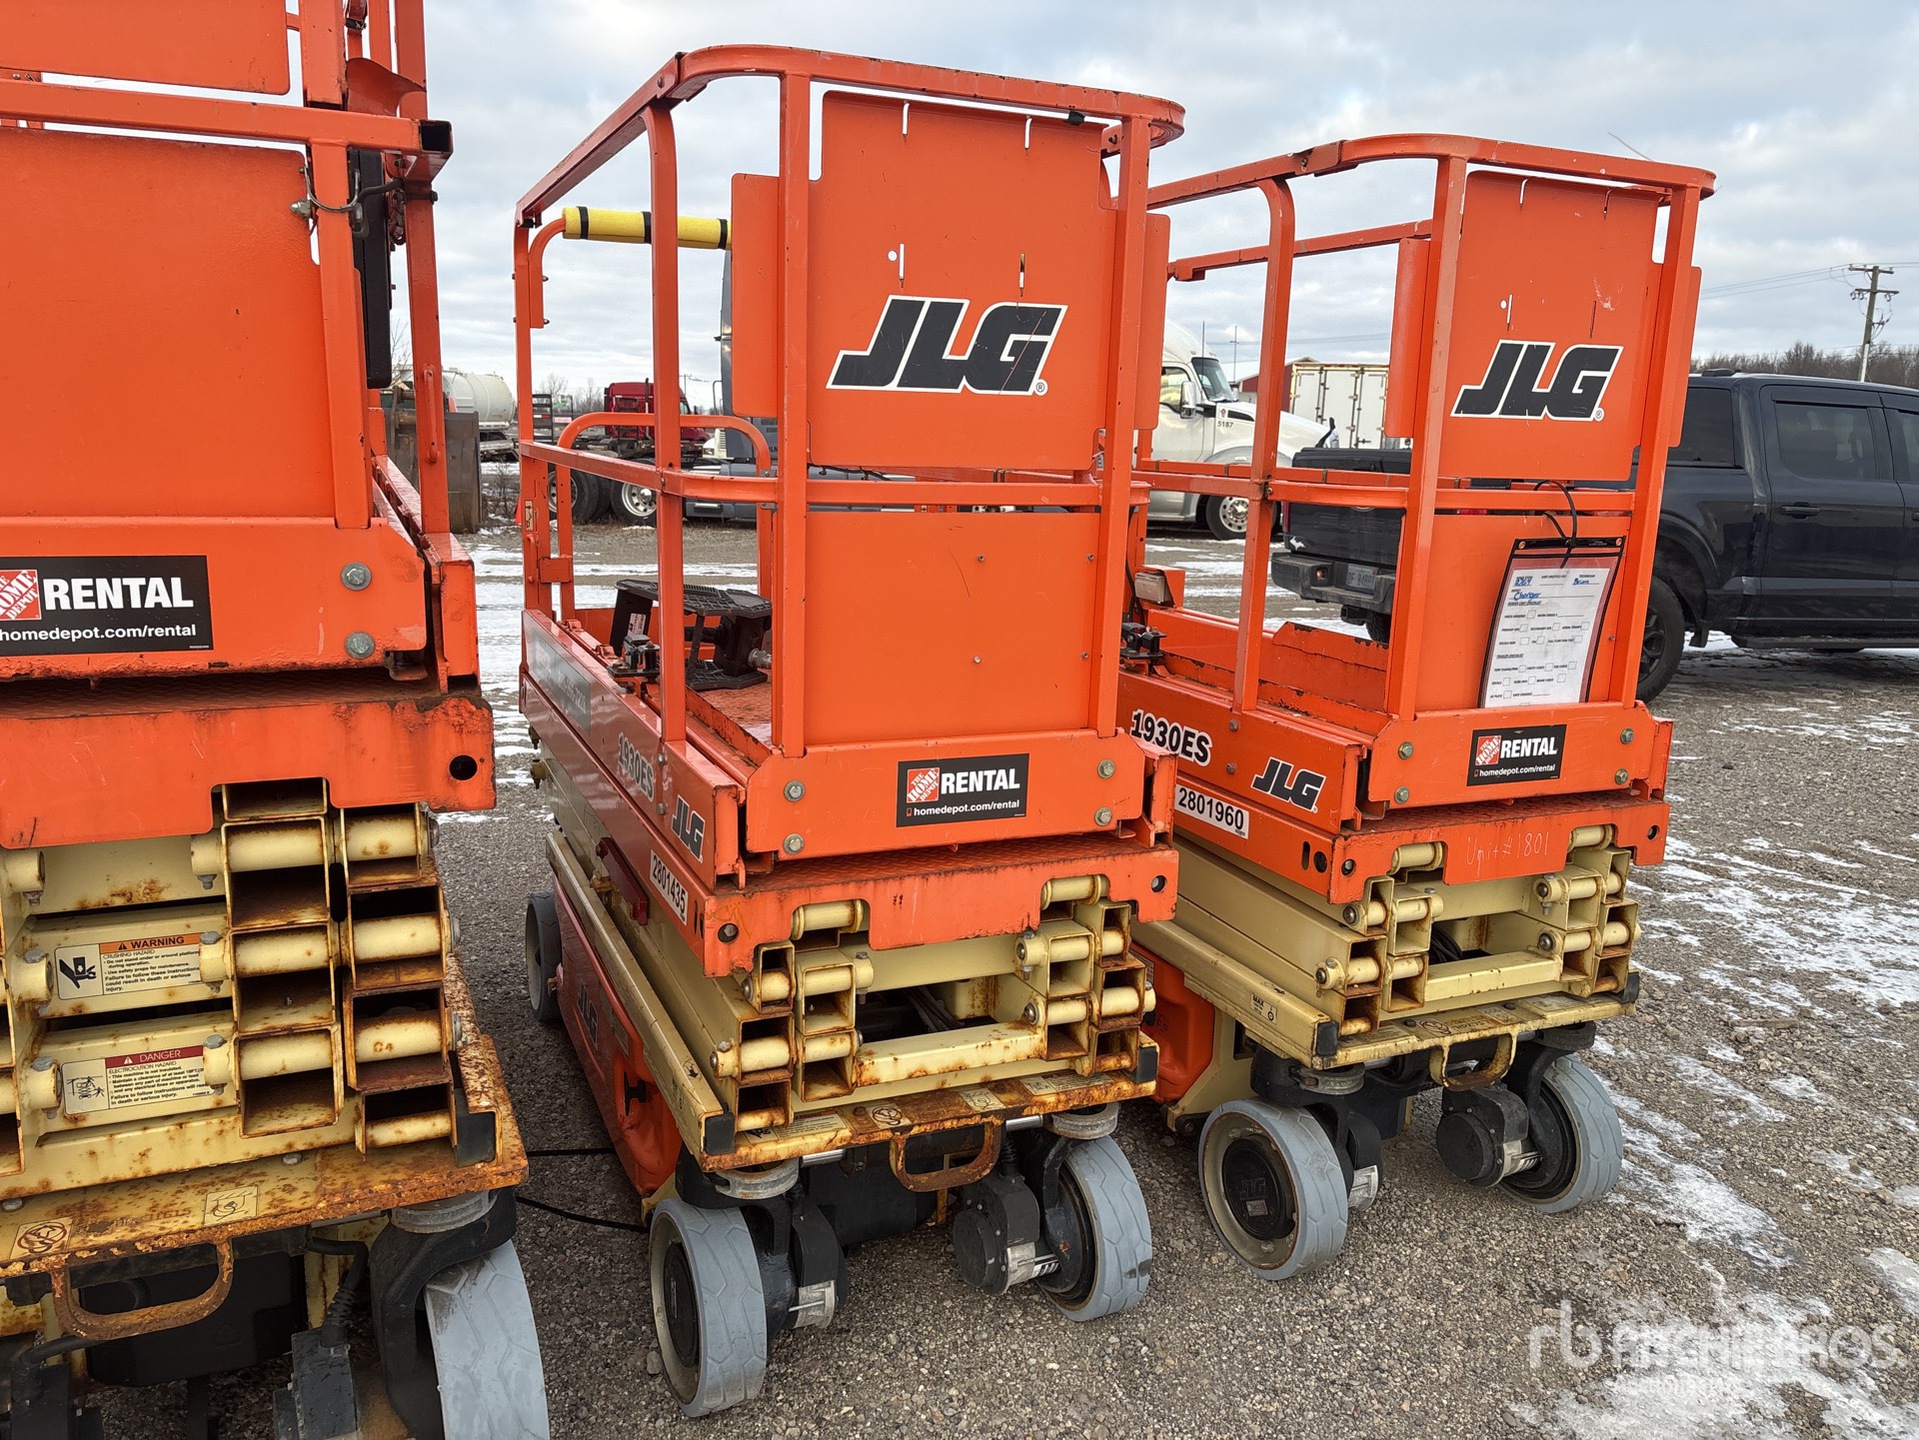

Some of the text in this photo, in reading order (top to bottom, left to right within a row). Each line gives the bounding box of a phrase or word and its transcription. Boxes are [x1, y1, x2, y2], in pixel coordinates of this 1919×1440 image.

[826, 294, 1068, 395] JLG
[1450, 339, 1624, 421] JLG
[43, 577, 194, 610] RENTAL
[0, 624, 196, 642] homedepot.com/rental
[1131, 710, 1212, 766] 1930ES
[1501, 737, 1558, 759] RENTAL
[618, 731, 654, 802] 1930ES
[941, 768, 1020, 794] RENTAL
[1479, 763, 1556, 777] homedepot.com/rental
[906, 767, 940, 803] HOME
[1251, 757, 1327, 813] JLG
[914, 800, 1020, 817] homedepot.com/rental
[1178, 787, 1245, 831] 2801960
[671, 794, 705, 863] JLG
[651, 854, 688, 915] 2801435
[131, 936, 185, 949] WARNING
[139, 1050, 181, 1062] DANGER
